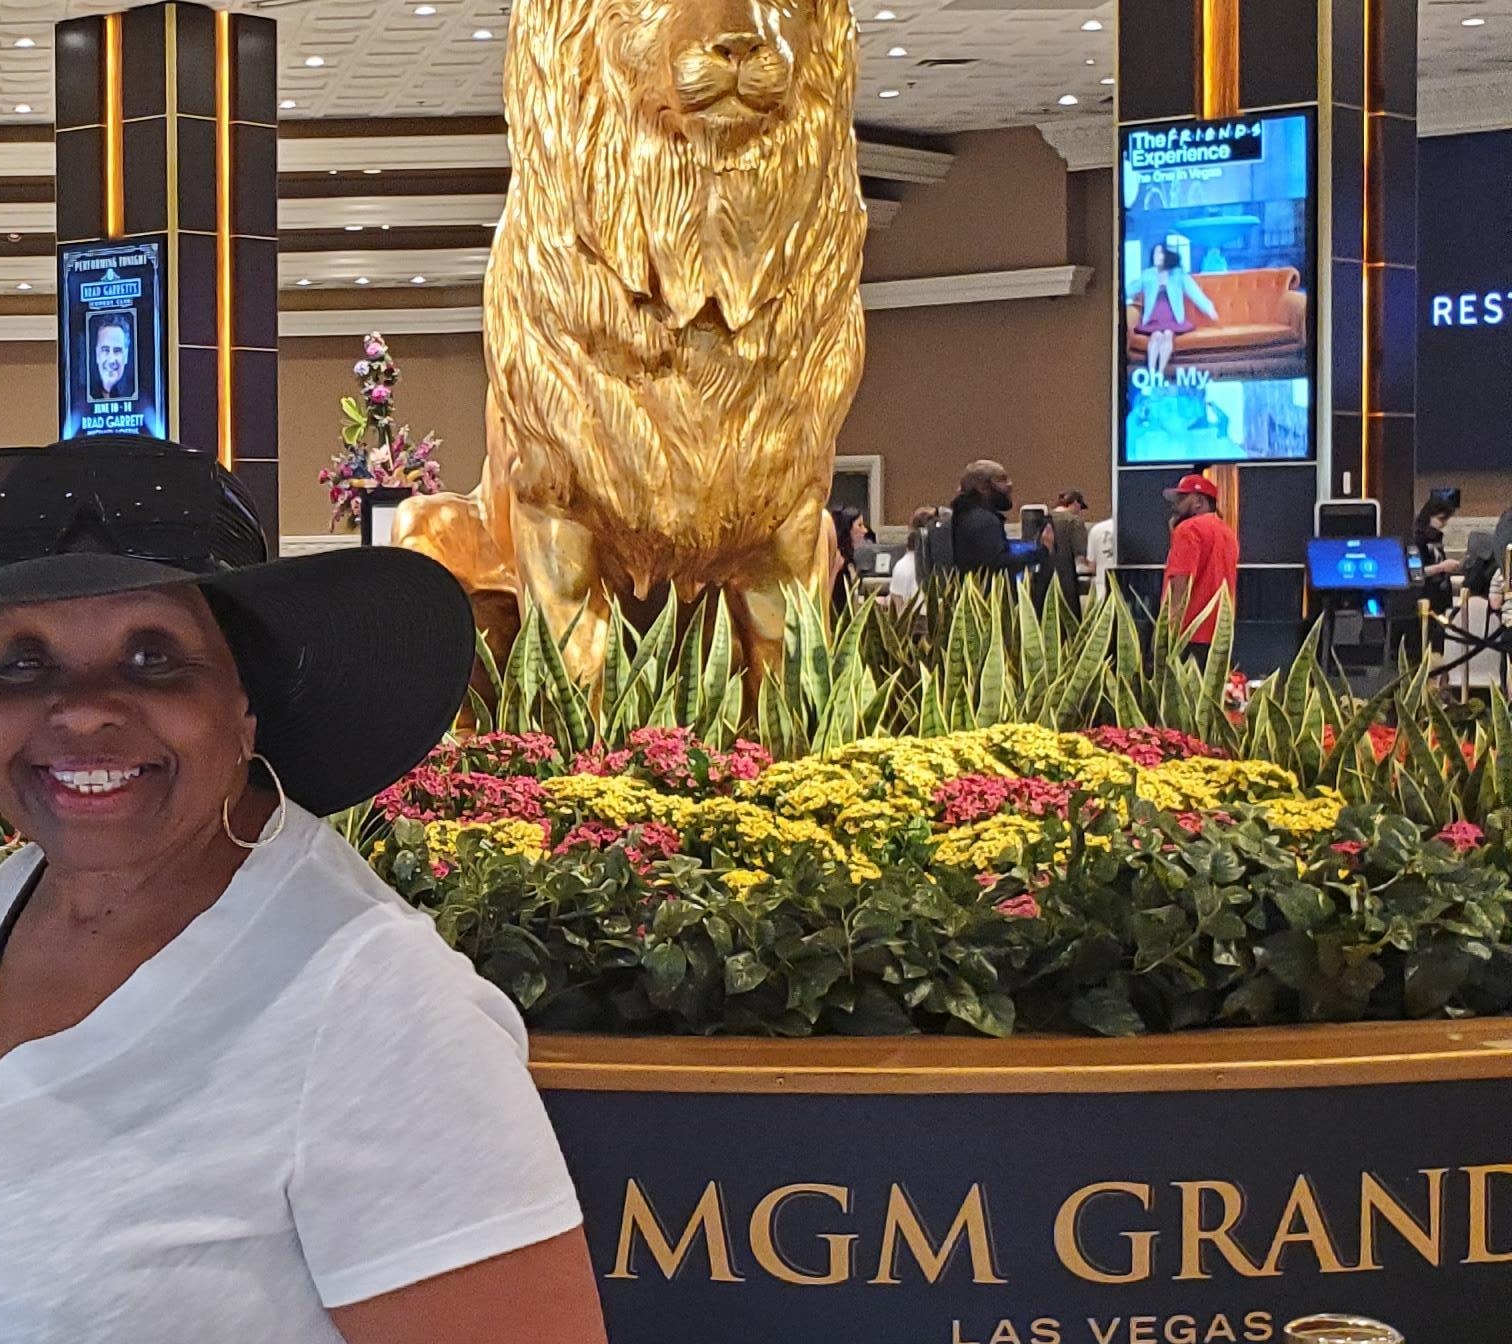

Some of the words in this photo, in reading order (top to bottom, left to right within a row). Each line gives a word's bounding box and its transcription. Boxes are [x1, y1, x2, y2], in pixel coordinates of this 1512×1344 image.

[1131, 131, 1166, 149] The
[1132, 144, 1231, 168] Experience
[1433, 292, 1512, 327] RES
[81, 416, 104, 430] BRAD
[105, 414, 145, 428] GARRETT
[604, 1177, 1009, 1284] MGM
